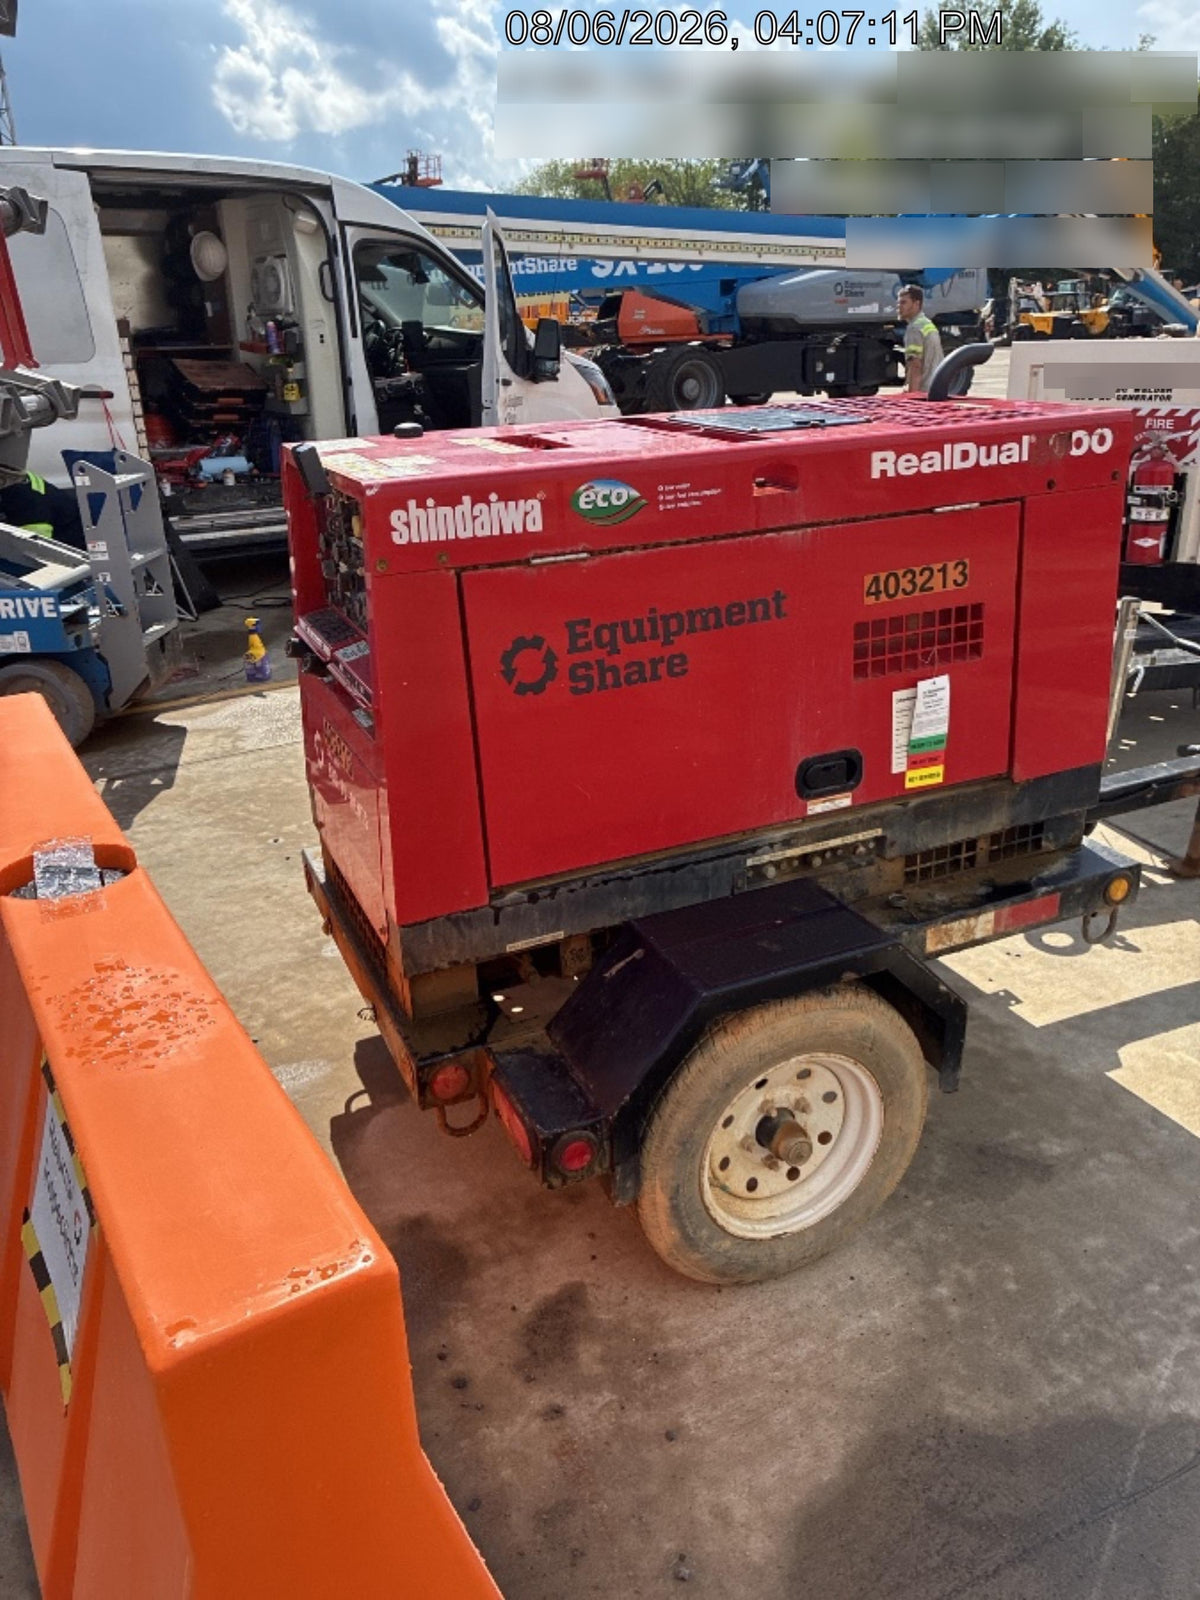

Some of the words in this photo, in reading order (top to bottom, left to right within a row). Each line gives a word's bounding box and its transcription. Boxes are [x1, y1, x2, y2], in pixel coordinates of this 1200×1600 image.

[1115, 394, 1173, 402] GENERATOR
[1144, 417, 1175, 430] FIRE
[1060, 428, 1113, 457] 00
[865, 560, 969, 602] 403213
[564, 589, 788, 656] Equipment
[567, 651, 690, 696] Share
